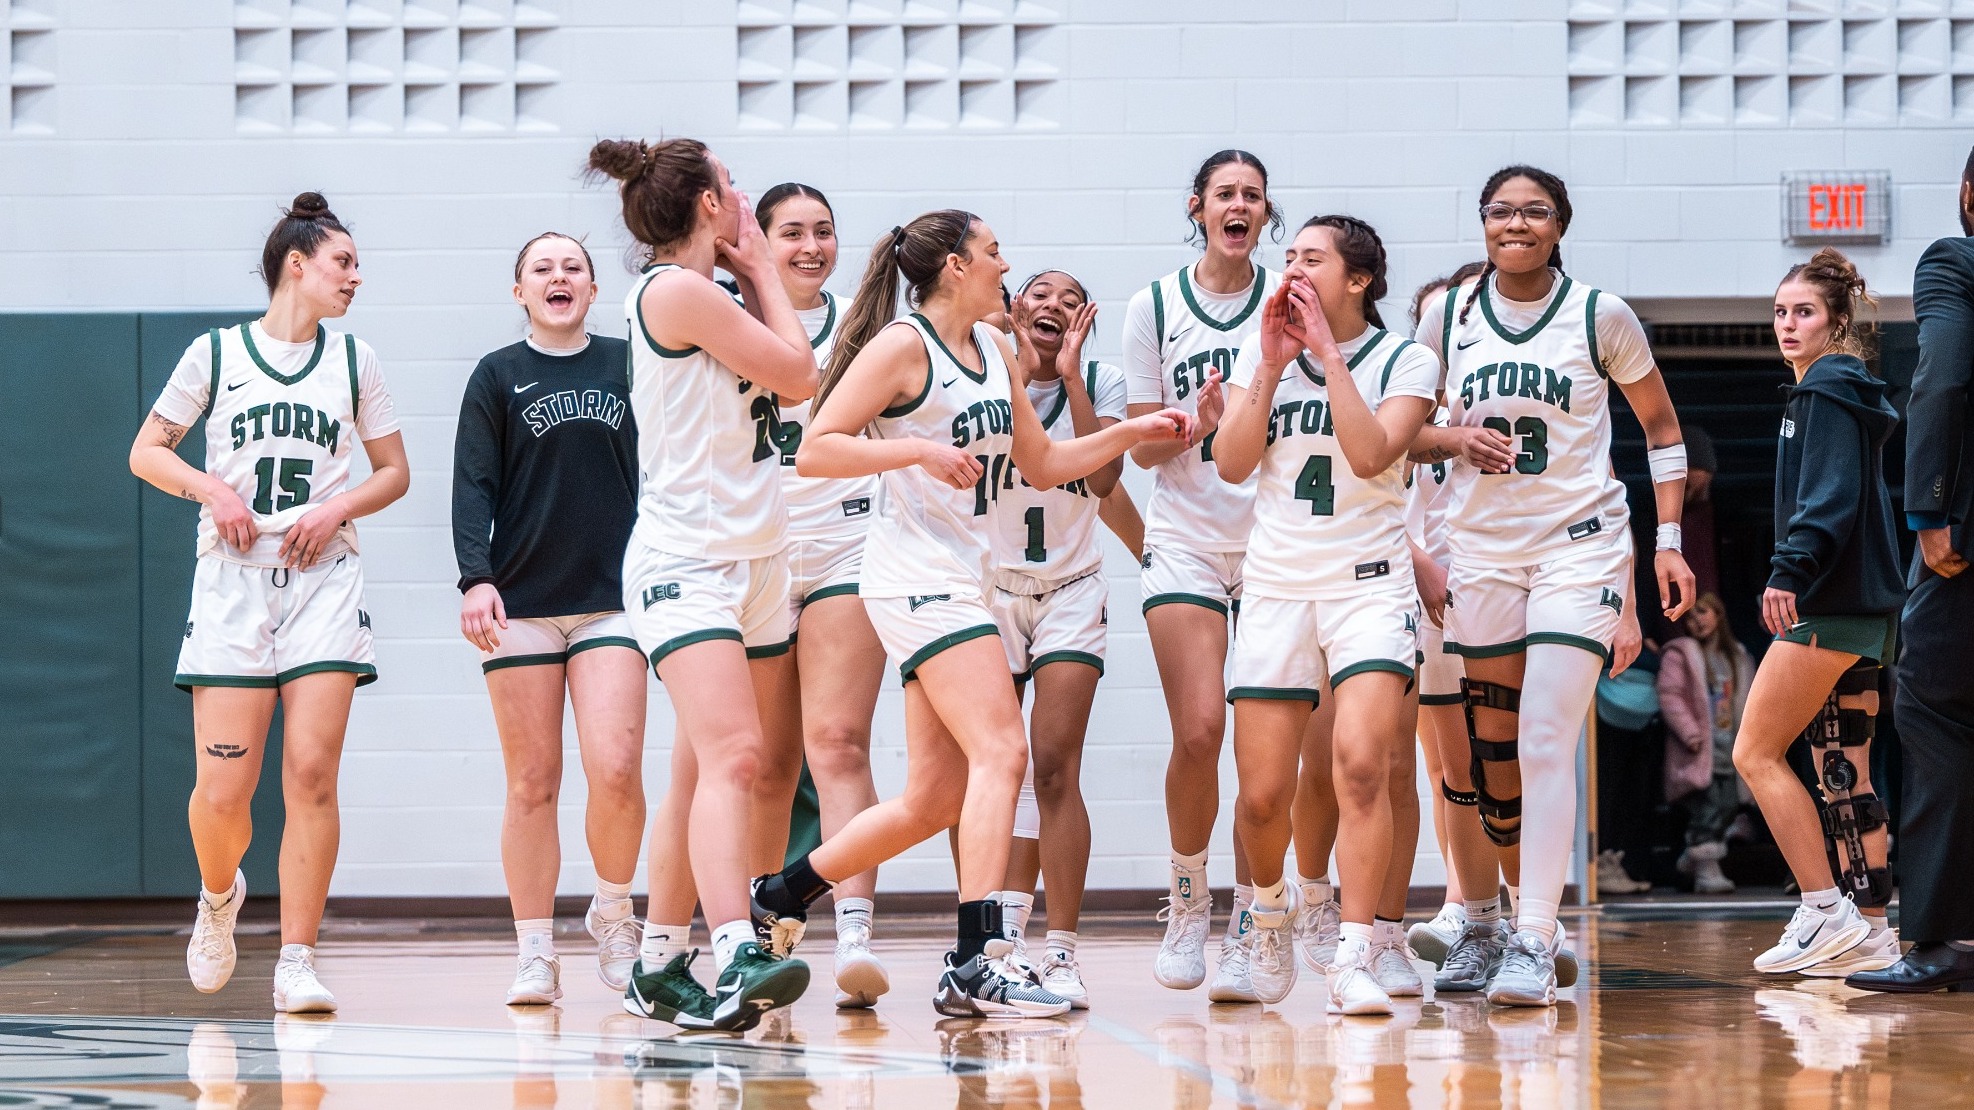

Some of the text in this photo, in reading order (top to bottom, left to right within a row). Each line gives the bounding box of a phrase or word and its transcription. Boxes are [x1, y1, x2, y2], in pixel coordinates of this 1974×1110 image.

[1808, 184, 1866, 229] EXIT
[522, 390, 626, 437] STORM
[1460, 362, 1572, 414] STORM
[231, 402, 341, 457] STORM
[952, 399, 1013, 449] STOR
[253, 457, 313, 515] 15
[1294, 455, 1335, 516] 4
[1025, 507, 1047, 562] 1
[643, 582, 681, 612] LEC
